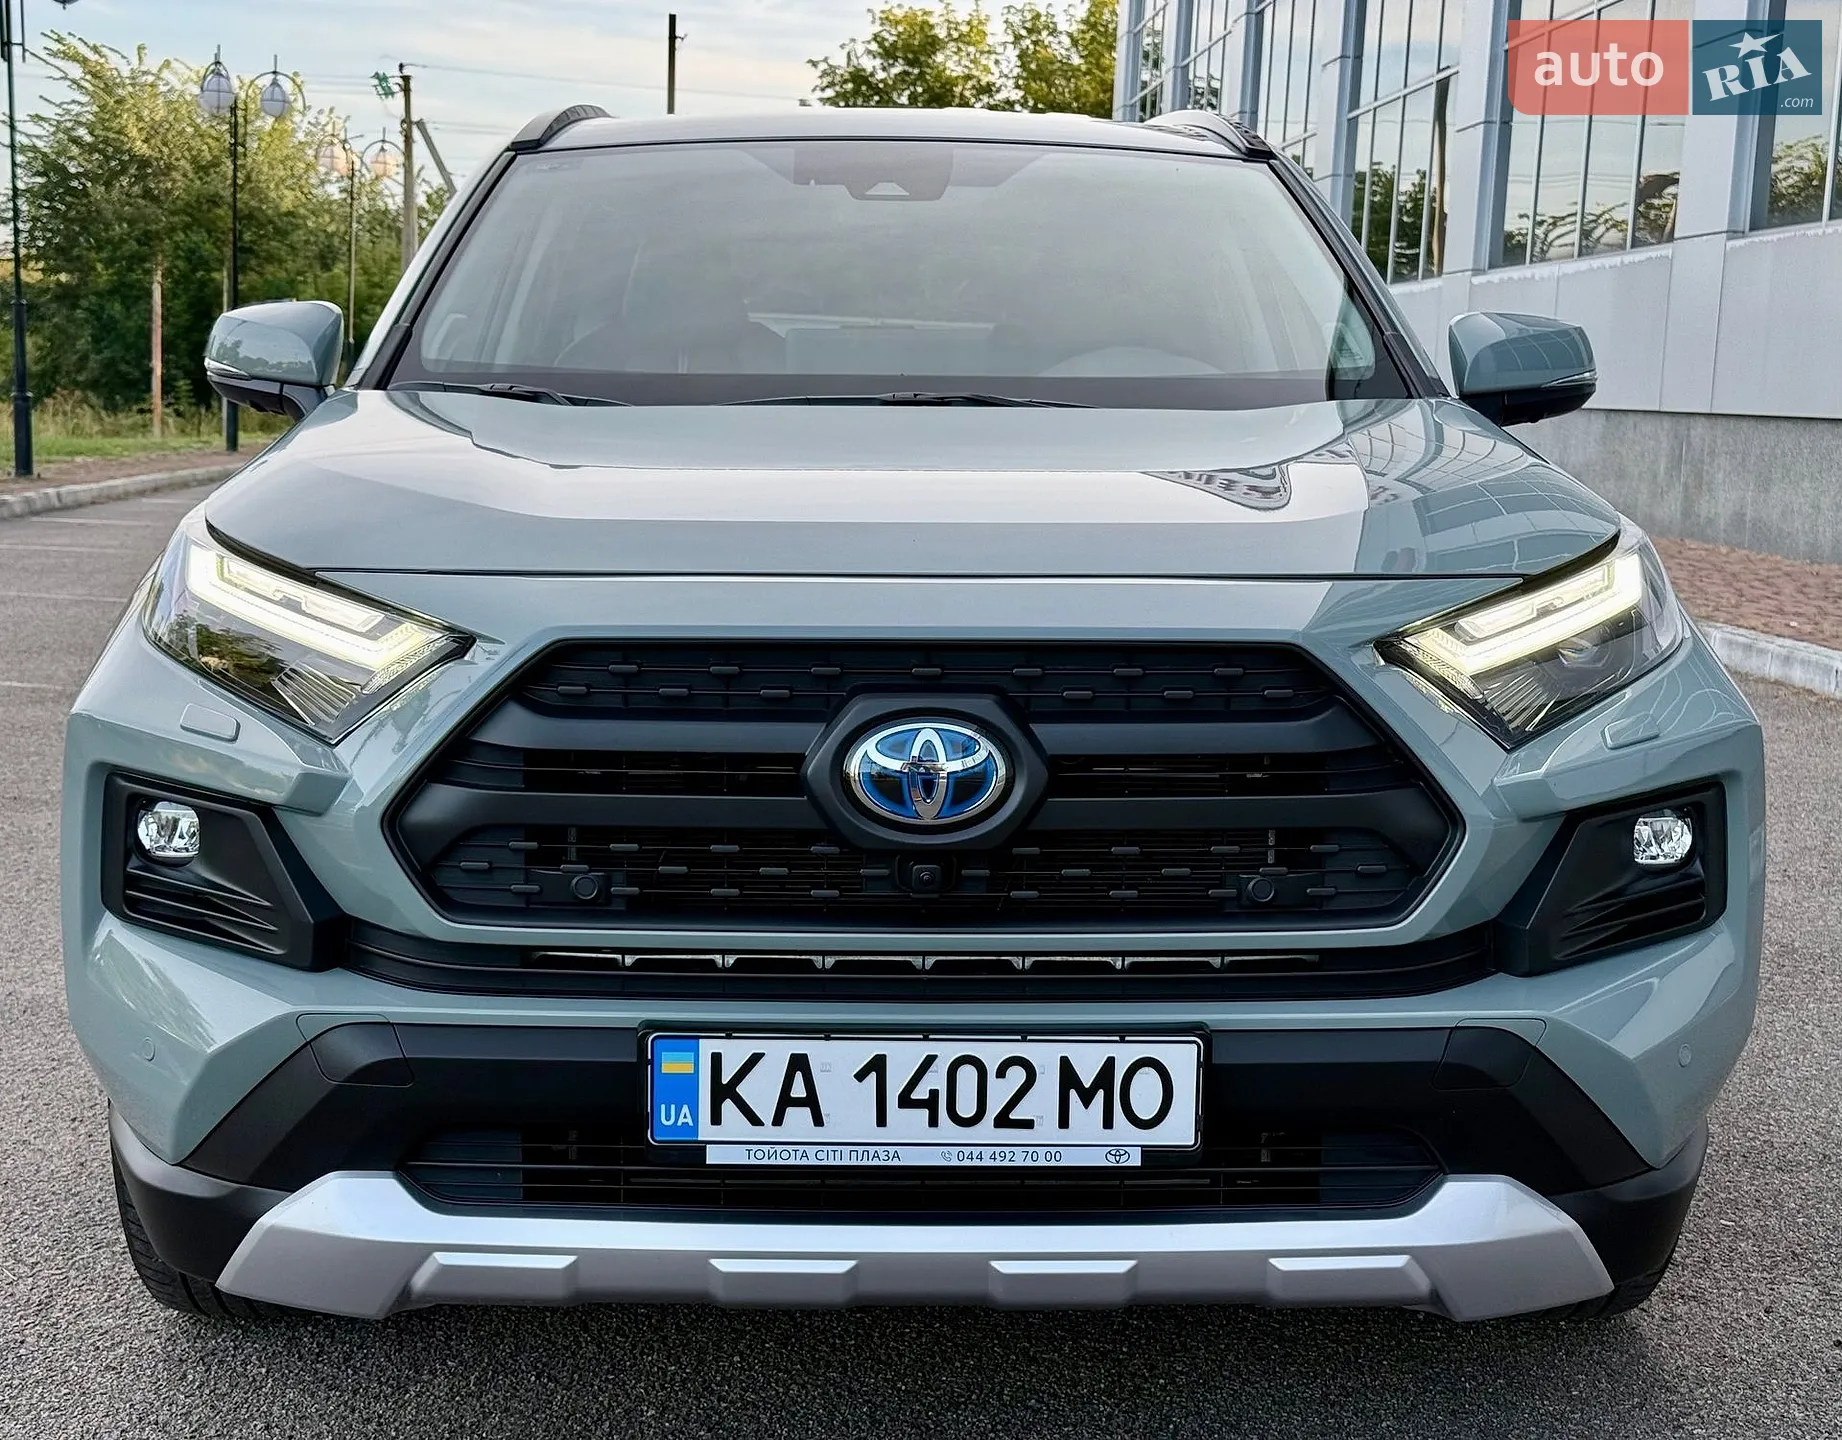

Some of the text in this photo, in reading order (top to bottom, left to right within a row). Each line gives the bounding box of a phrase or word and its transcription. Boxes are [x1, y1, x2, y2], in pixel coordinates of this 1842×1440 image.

[709, 1052, 1174, 1130] KA 1402 MO
[660, 1104, 694, 1127] UA
[745, 1147, 810, 1161] ТОЙОТА
[849, 1149, 901, 1162] ПЛАЗА
[956, 1150, 1063, 1162] 044 492 70 00
